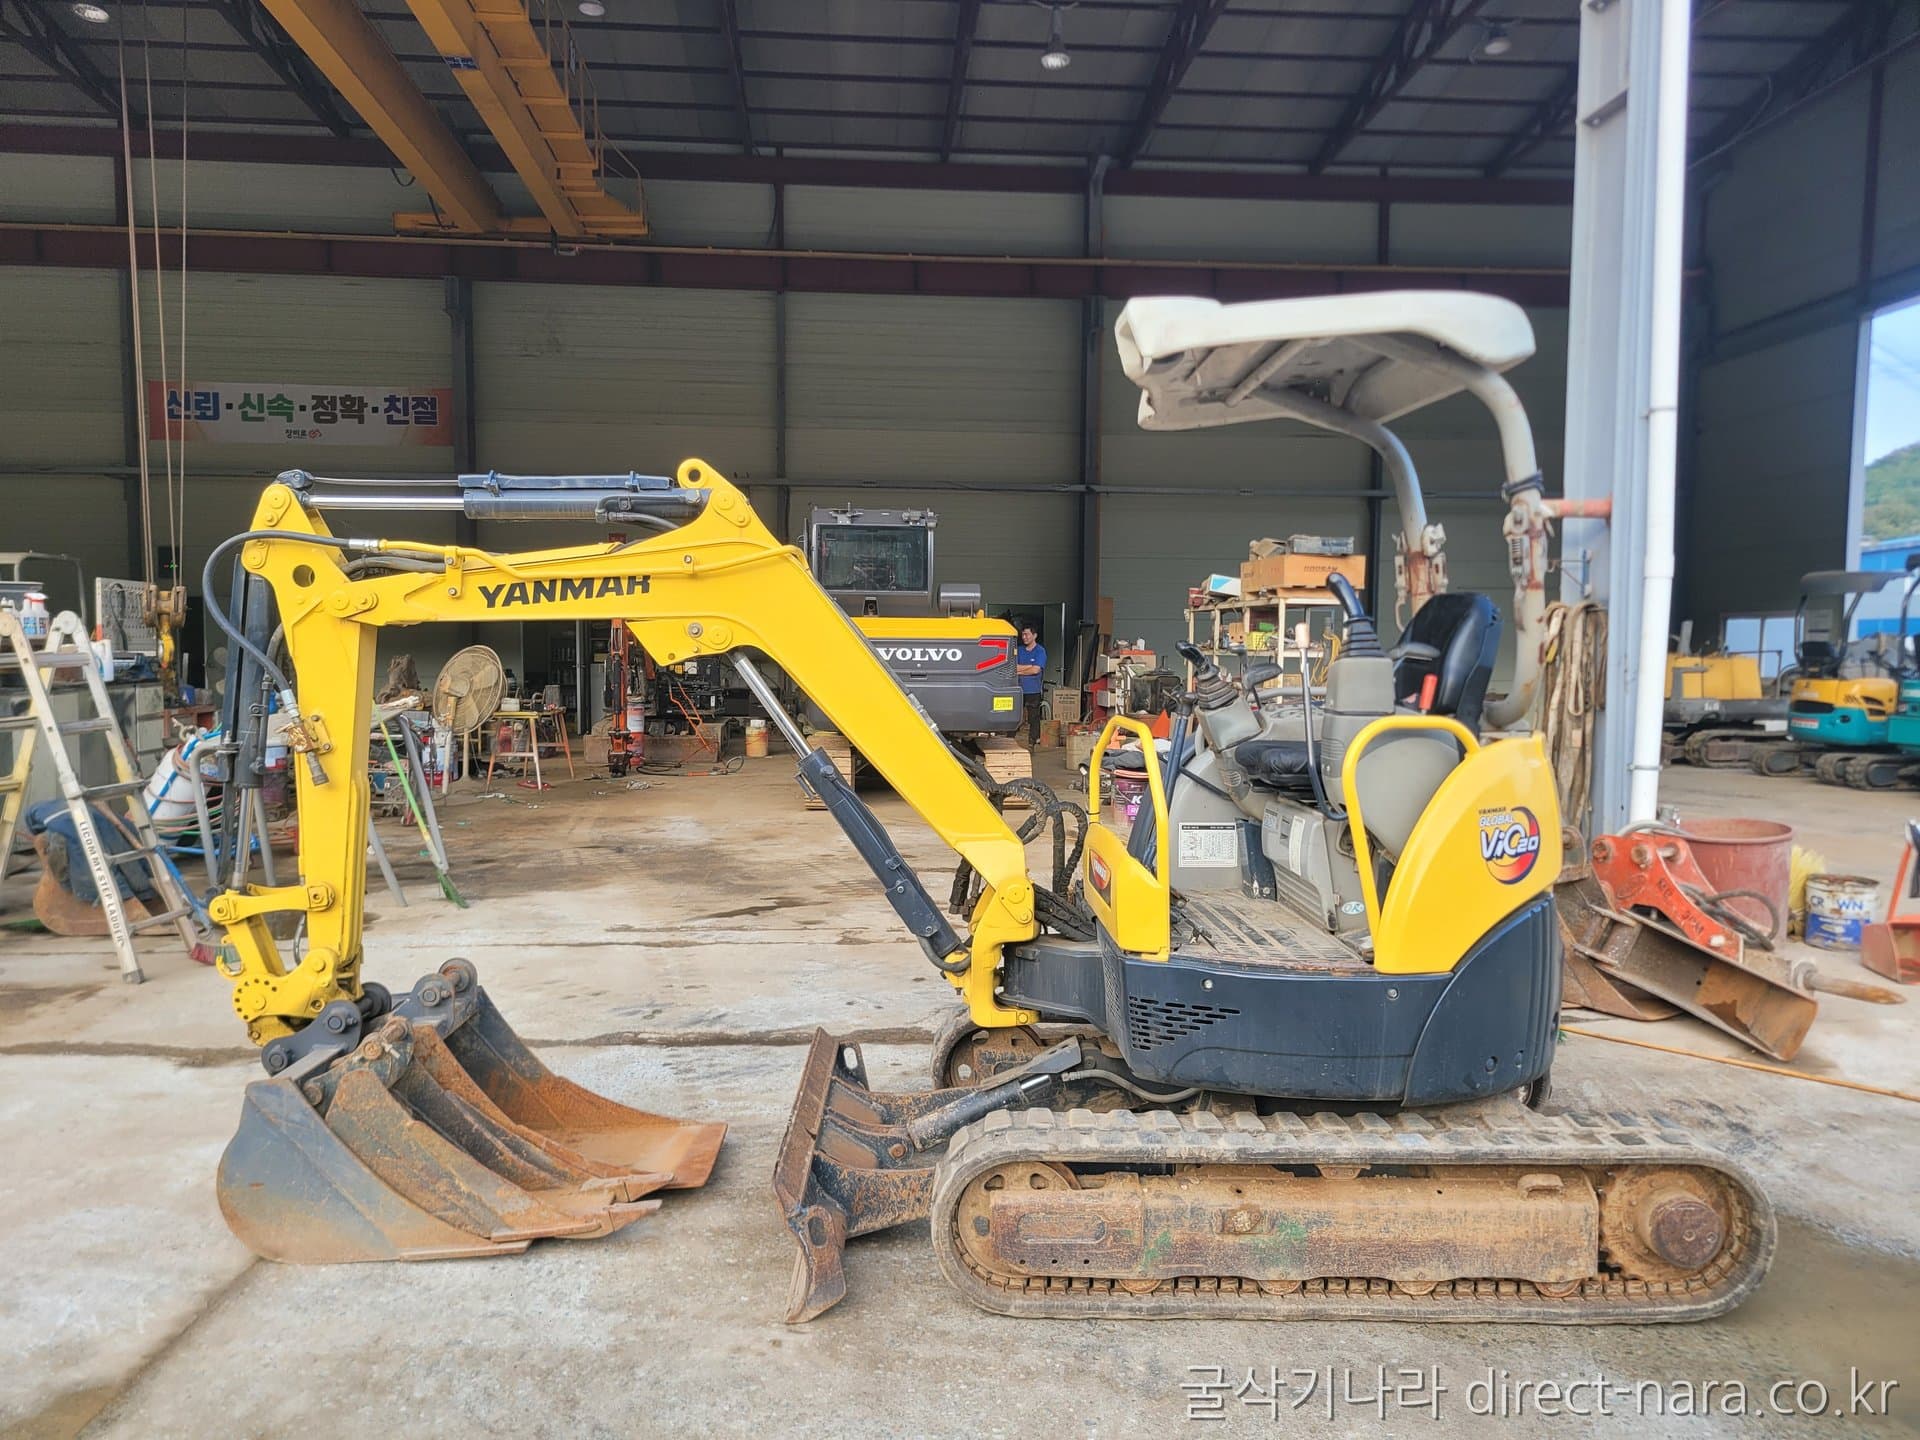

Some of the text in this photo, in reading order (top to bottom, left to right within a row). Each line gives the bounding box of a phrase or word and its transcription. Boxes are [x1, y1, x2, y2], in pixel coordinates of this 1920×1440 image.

[167, 390, 439, 426] 신뢰 신속 정확 친절
[478, 574, 651, 609] YANMAR
[875, 647, 963, 661] VOLVO
